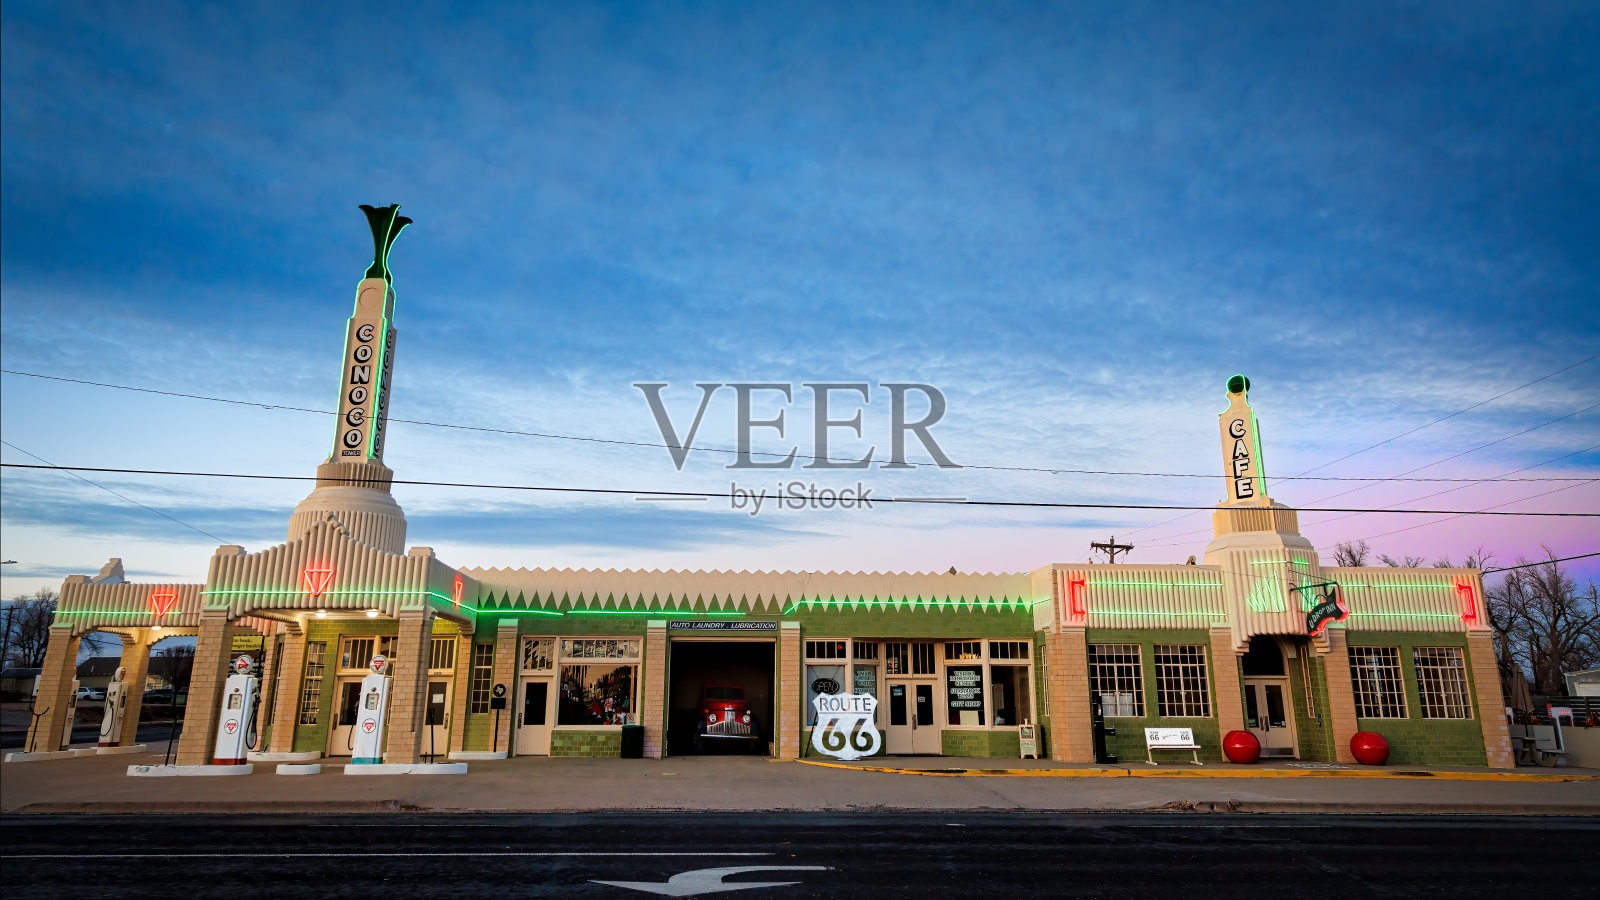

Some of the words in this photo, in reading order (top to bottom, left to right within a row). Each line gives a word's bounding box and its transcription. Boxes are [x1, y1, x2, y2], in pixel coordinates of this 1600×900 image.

[344, 324, 374, 448] CONOCO
[374, 330, 392, 452] CONOCO
[1229, 419, 1253, 499] CAFE
[814, 681, 835, 692] OPEN
[820, 698, 871, 711] ROUTE
[822, 718, 874, 751] 66
